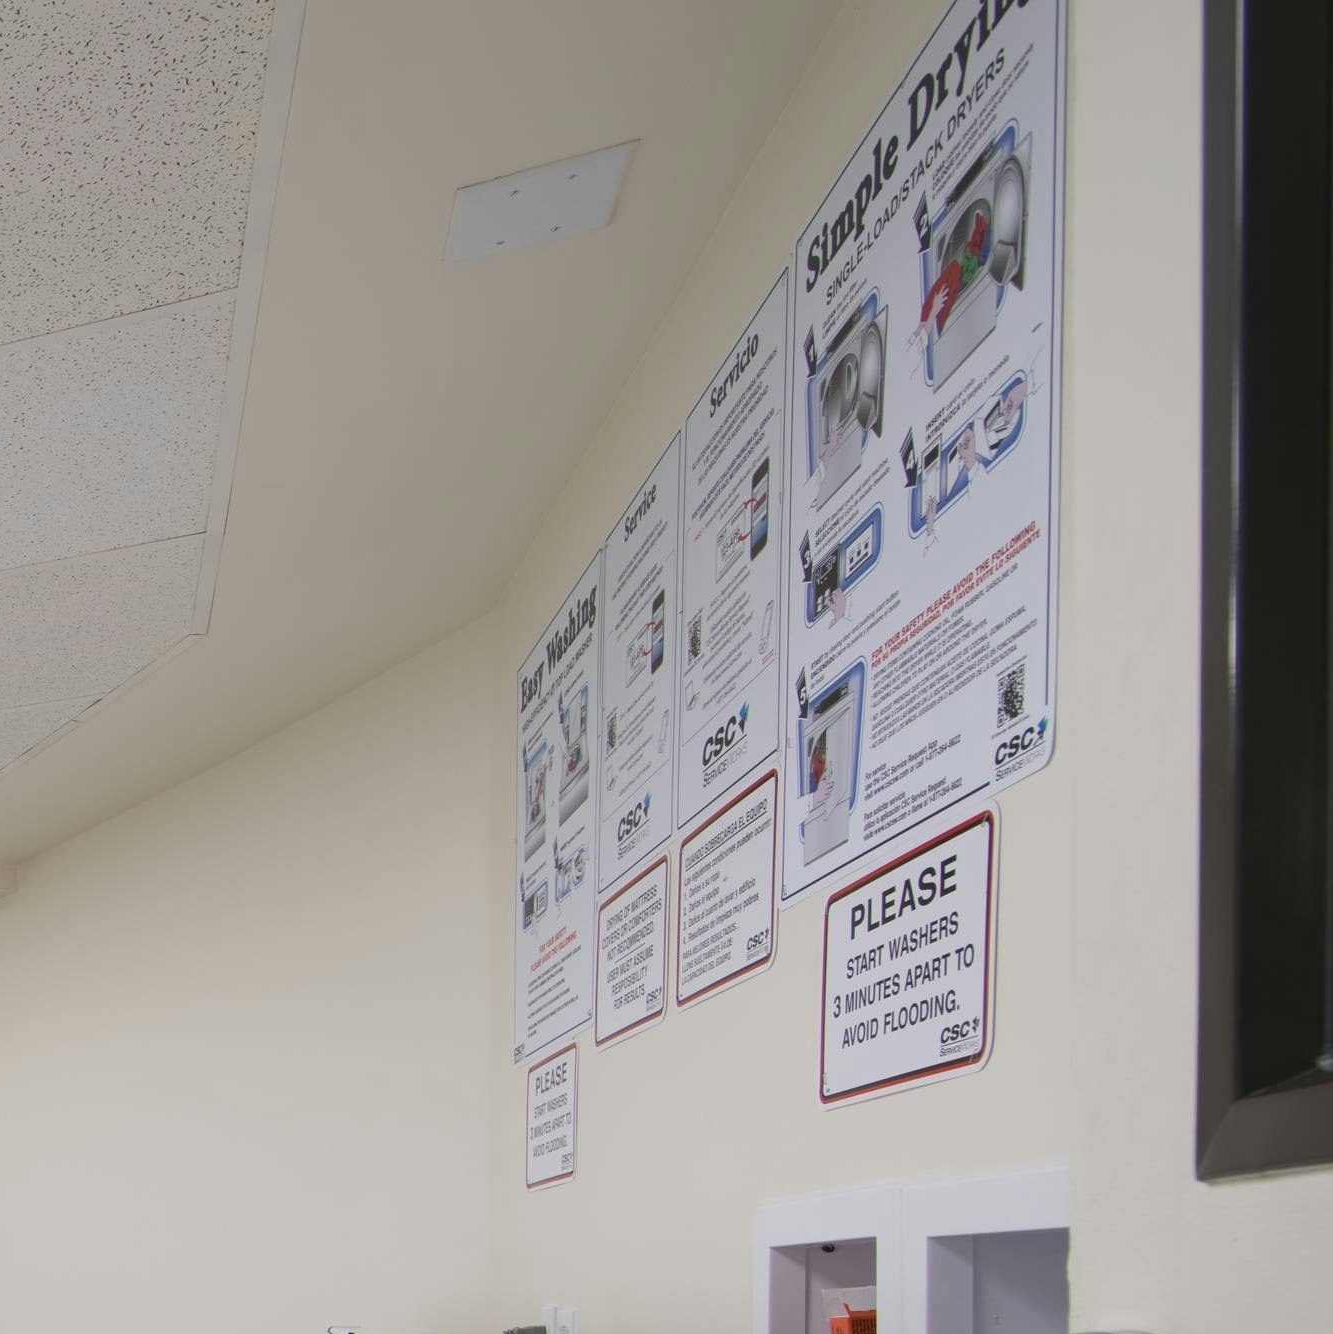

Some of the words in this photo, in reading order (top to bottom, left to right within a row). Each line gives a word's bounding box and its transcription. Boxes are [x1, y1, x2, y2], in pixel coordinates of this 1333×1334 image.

[806, 135, 899, 293] Simple
[907, 0, 1031, 151] Dryi
[826, 131, 943, 306] SINGLE-LOAD/STACK
[947, 48, 1005, 141] DRYERS
[710, 334, 759, 418] Servicio
[624, 484, 656, 542] Service
[872, 646, 883, 661] FOR
[884, 632, 900, 649] YOUR
[901, 611, 924, 636] SAFETY
[926, 590, 951, 616] PLEASE
[953, 572, 973, 595] AVOID
[975, 558, 989, 576] THE
[991, 521, 1036, 563] FOLLOWING
[890, 636, 908, 655] PROPIA
[956, 582, 975, 603] FAVOR
[976, 566, 994, 587] EVITE
[996, 559, 1004, 571] LO
[1005, 529, 1040, 563] SIGUIENTE
[521, 661, 544, 714] Easy
[547, 585, 597, 675] Washing
[702, 716, 737, 766] CSC
[881, 768, 890, 781] CSC
[891, 759, 907, 775] Service
[908, 745, 927, 763] Request
[995, 726, 1035, 765] CSC
[618, 802, 642, 842] CSC
[911, 789, 927, 804] Service
[685, 846, 704, 868] CUANDO
[705, 821, 737, 854] SOBRECARGA
[738, 816, 745, 828] EL
[746, 798, 767, 822] EQUIPO
[602, 928, 620, 950] COVERS
[621, 923, 627, 937] OR
[628, 898, 662, 931] COMFORTERS
[624, 904, 630, 918] OF
[631, 884, 657, 912] MATTRESS
[851, 854, 957, 940] PLEASE
[747, 931, 764, 951] CSC
[847, 944, 884, 979] START
[889, 911, 958, 960] WASHERS
[833, 995, 841, 1018] 3
[845, 973, 900, 1014] MINUTES
[904, 952, 951, 991] APART
[955, 944, 974, 971] TO
[842, 1018, 879, 1049] AVOID
[883, 989, 960, 1034] FLOODING.
[940, 1021, 970, 1044] CSC
[536, 1062, 567, 1096] PLEASE
